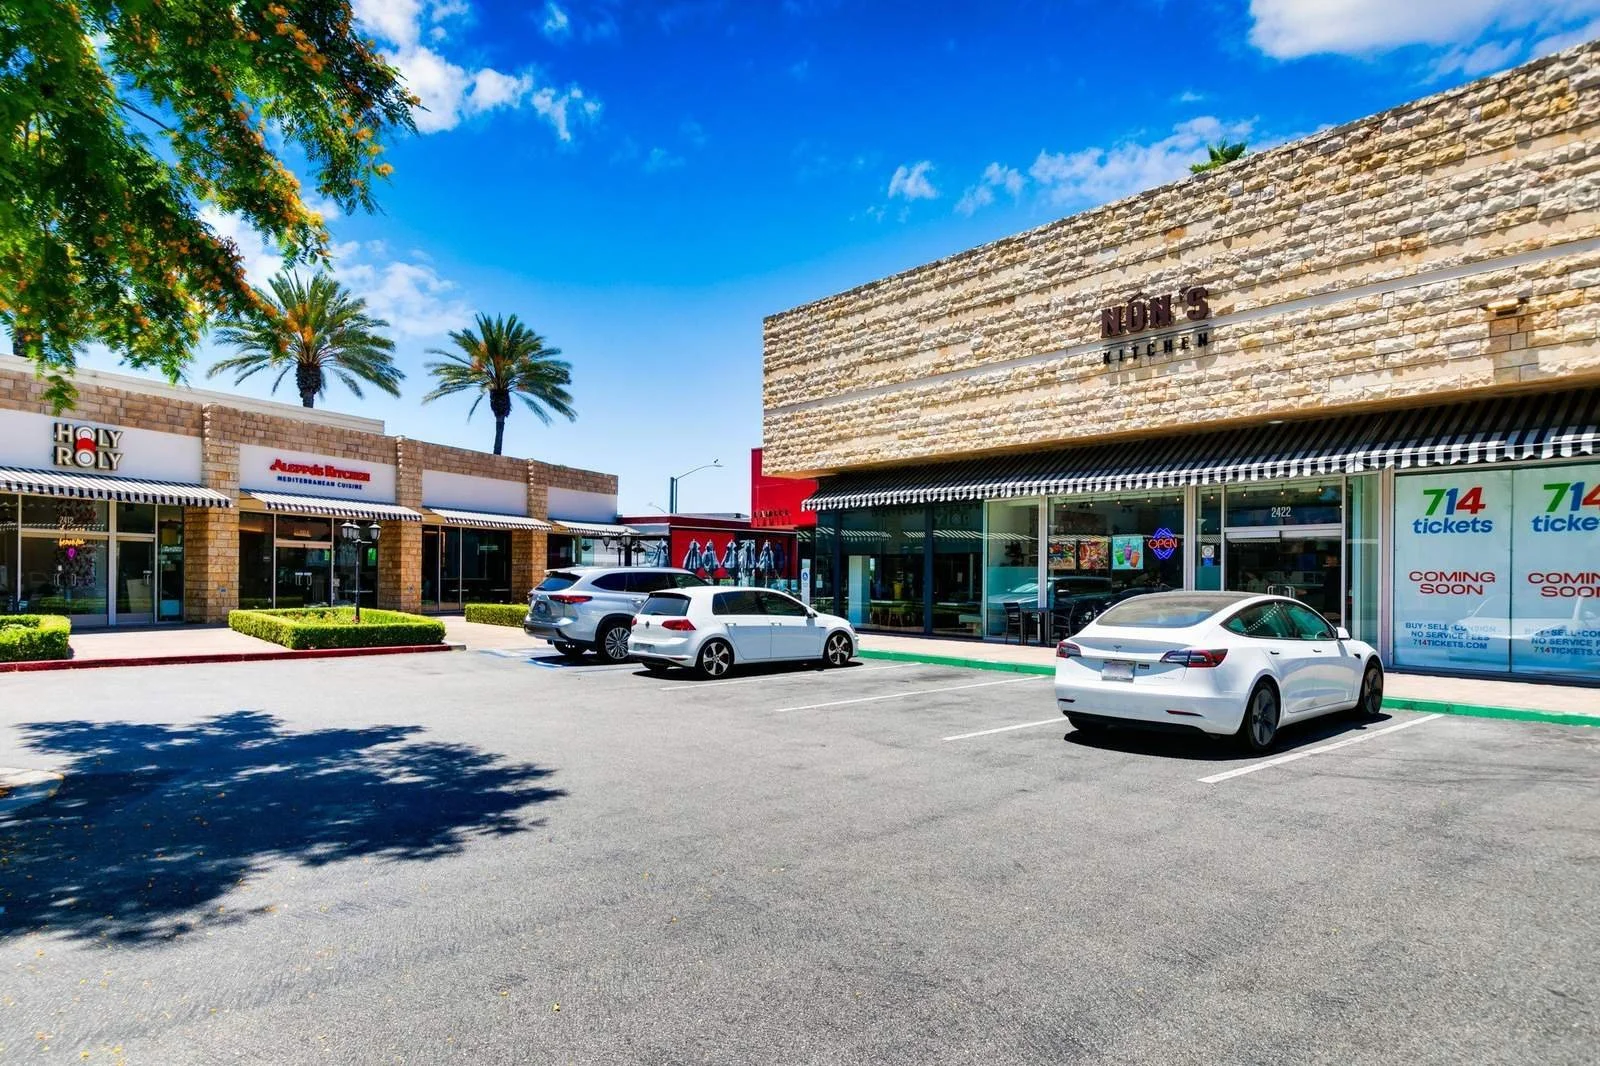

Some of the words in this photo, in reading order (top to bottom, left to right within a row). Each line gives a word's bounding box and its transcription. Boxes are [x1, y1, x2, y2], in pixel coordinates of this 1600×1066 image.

[1103, 332, 1208, 364] KITCHEN
[54, 423, 123, 448] HOLY
[54, 446, 122, 470] ROLY
[337, 482, 362, 490] CUISINE
[1423, 486, 1486, 516] 714
[1271, 506, 1291, 518] 2422
[1412, 517, 1493, 534] tickets
[1531, 514, 1600, 532] ticke
[1148, 538, 1178, 549] OPEN
[1409, 571, 1496, 583] COMING
[1420, 583, 1483, 596] SOON
[1541, 586, 1600, 598] SOO
[1425, 632, 1464, 640] SERVICE
[1531, 637, 1546, 645] NO
[1549, 638, 1593, 647] SERVICE
[1413, 639, 1488, 650] 714TICKETS.COM
